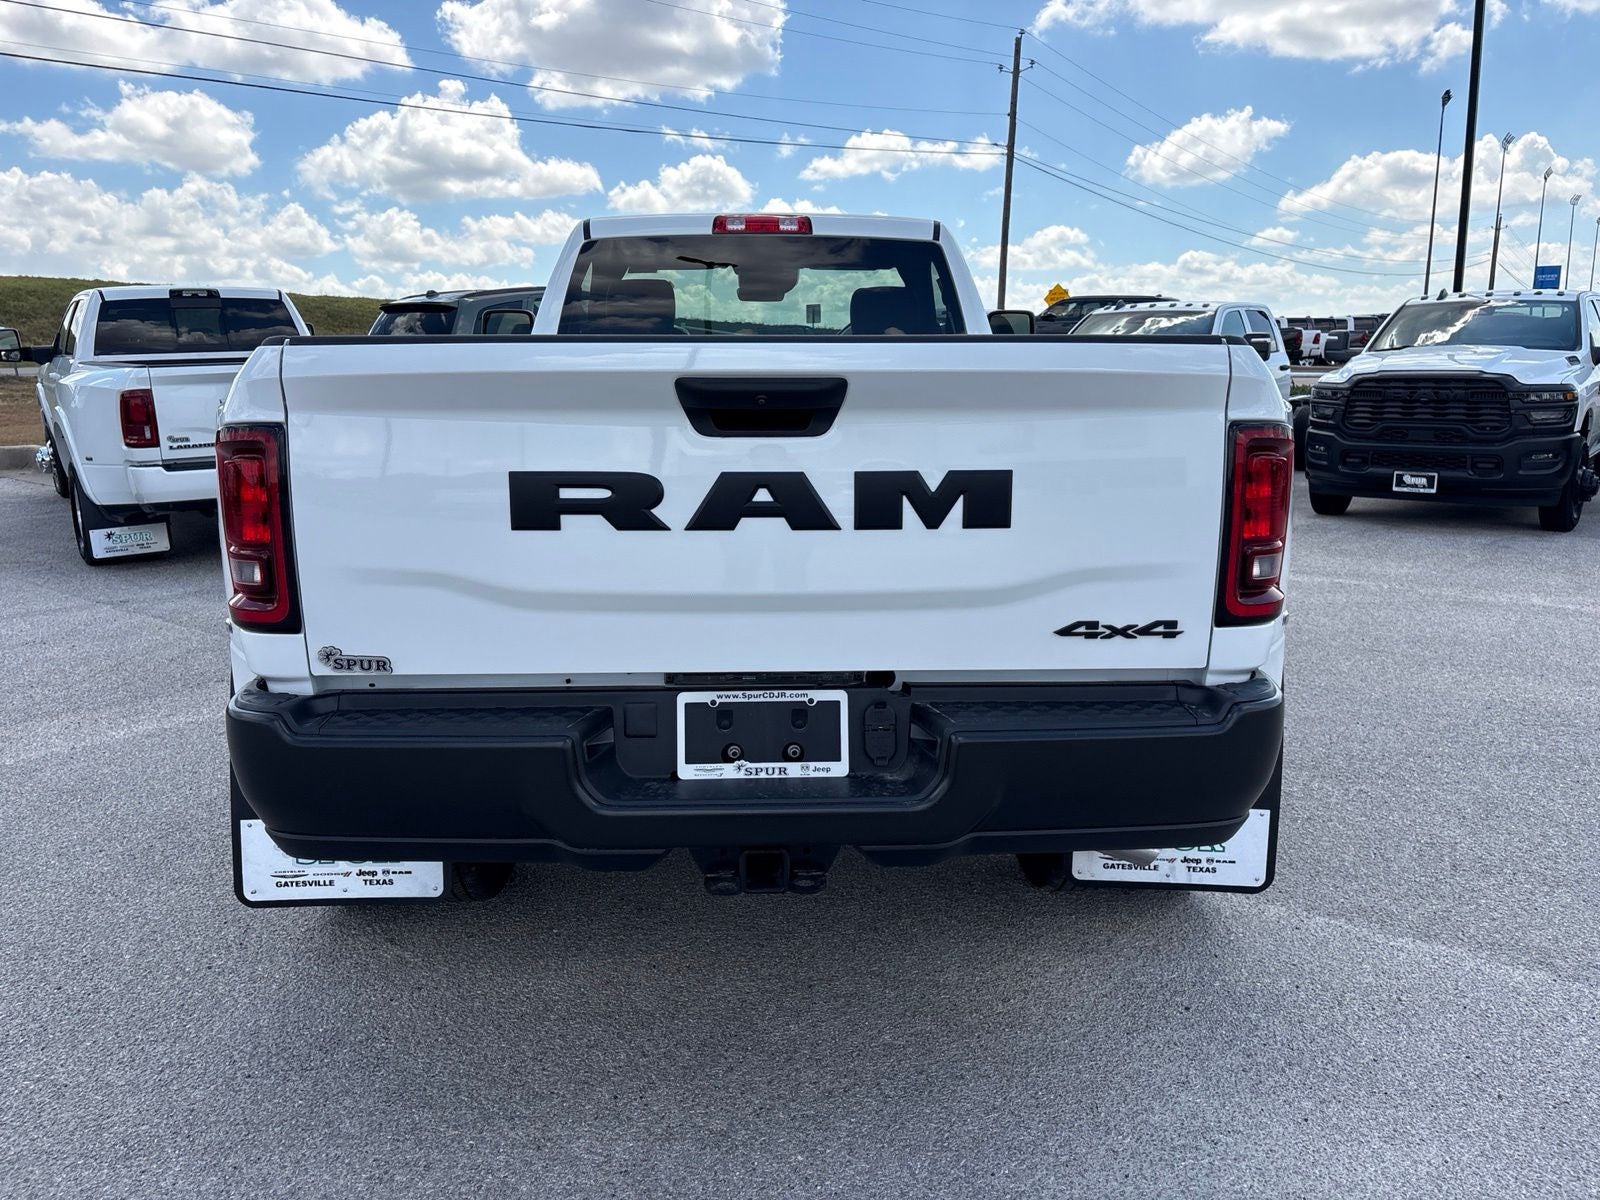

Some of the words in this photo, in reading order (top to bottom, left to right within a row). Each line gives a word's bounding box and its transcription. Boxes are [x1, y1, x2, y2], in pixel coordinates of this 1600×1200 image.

[508, 470, 1014, 531] RAM
[112, 531, 152, 545] SPUR
[1053, 620, 1184, 639] 4x4
[334, 658, 388, 672] SPUR
[716, 691, 809, 700] www.SpurCDJR.com
[744, 766, 789, 776] SPUR
[1180, 856, 1202, 865] Jeep
[355, 868, 378, 877] Jeep
[1103, 862, 1160, 871] GATESVILLE
[1186, 866, 1217, 874] TEXAS
[275, 880, 336, 888] GATESVILLE
